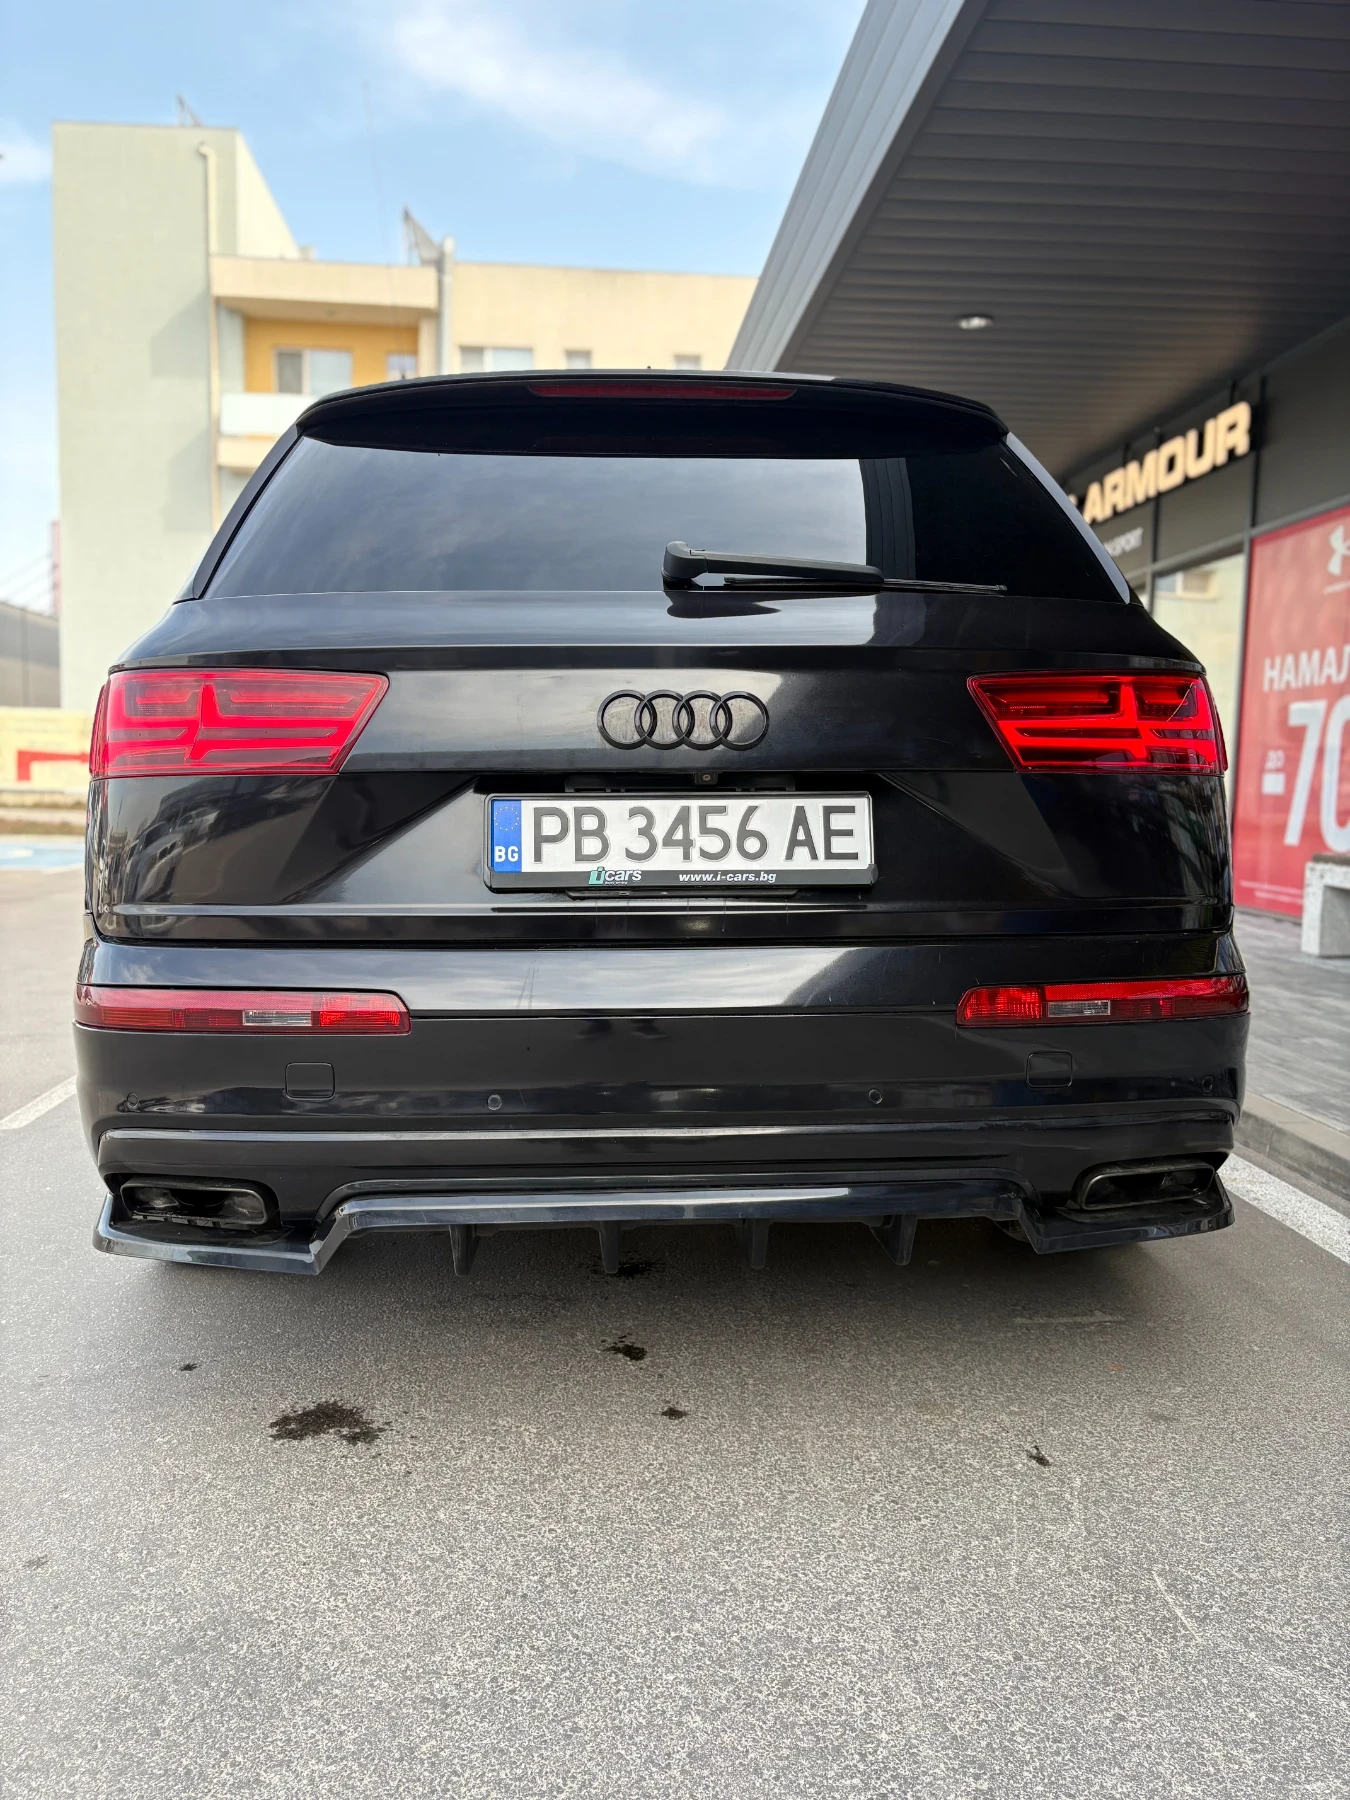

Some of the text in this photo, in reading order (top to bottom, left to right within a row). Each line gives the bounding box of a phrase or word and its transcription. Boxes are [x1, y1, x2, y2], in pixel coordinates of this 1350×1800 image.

[1083, 400, 1251, 525] ARMOUR
[533, 805, 860, 863] PB 3456 AE
[494, 845, 519, 863] BG
[678, 871, 777, 883] www.i-cars.bg
